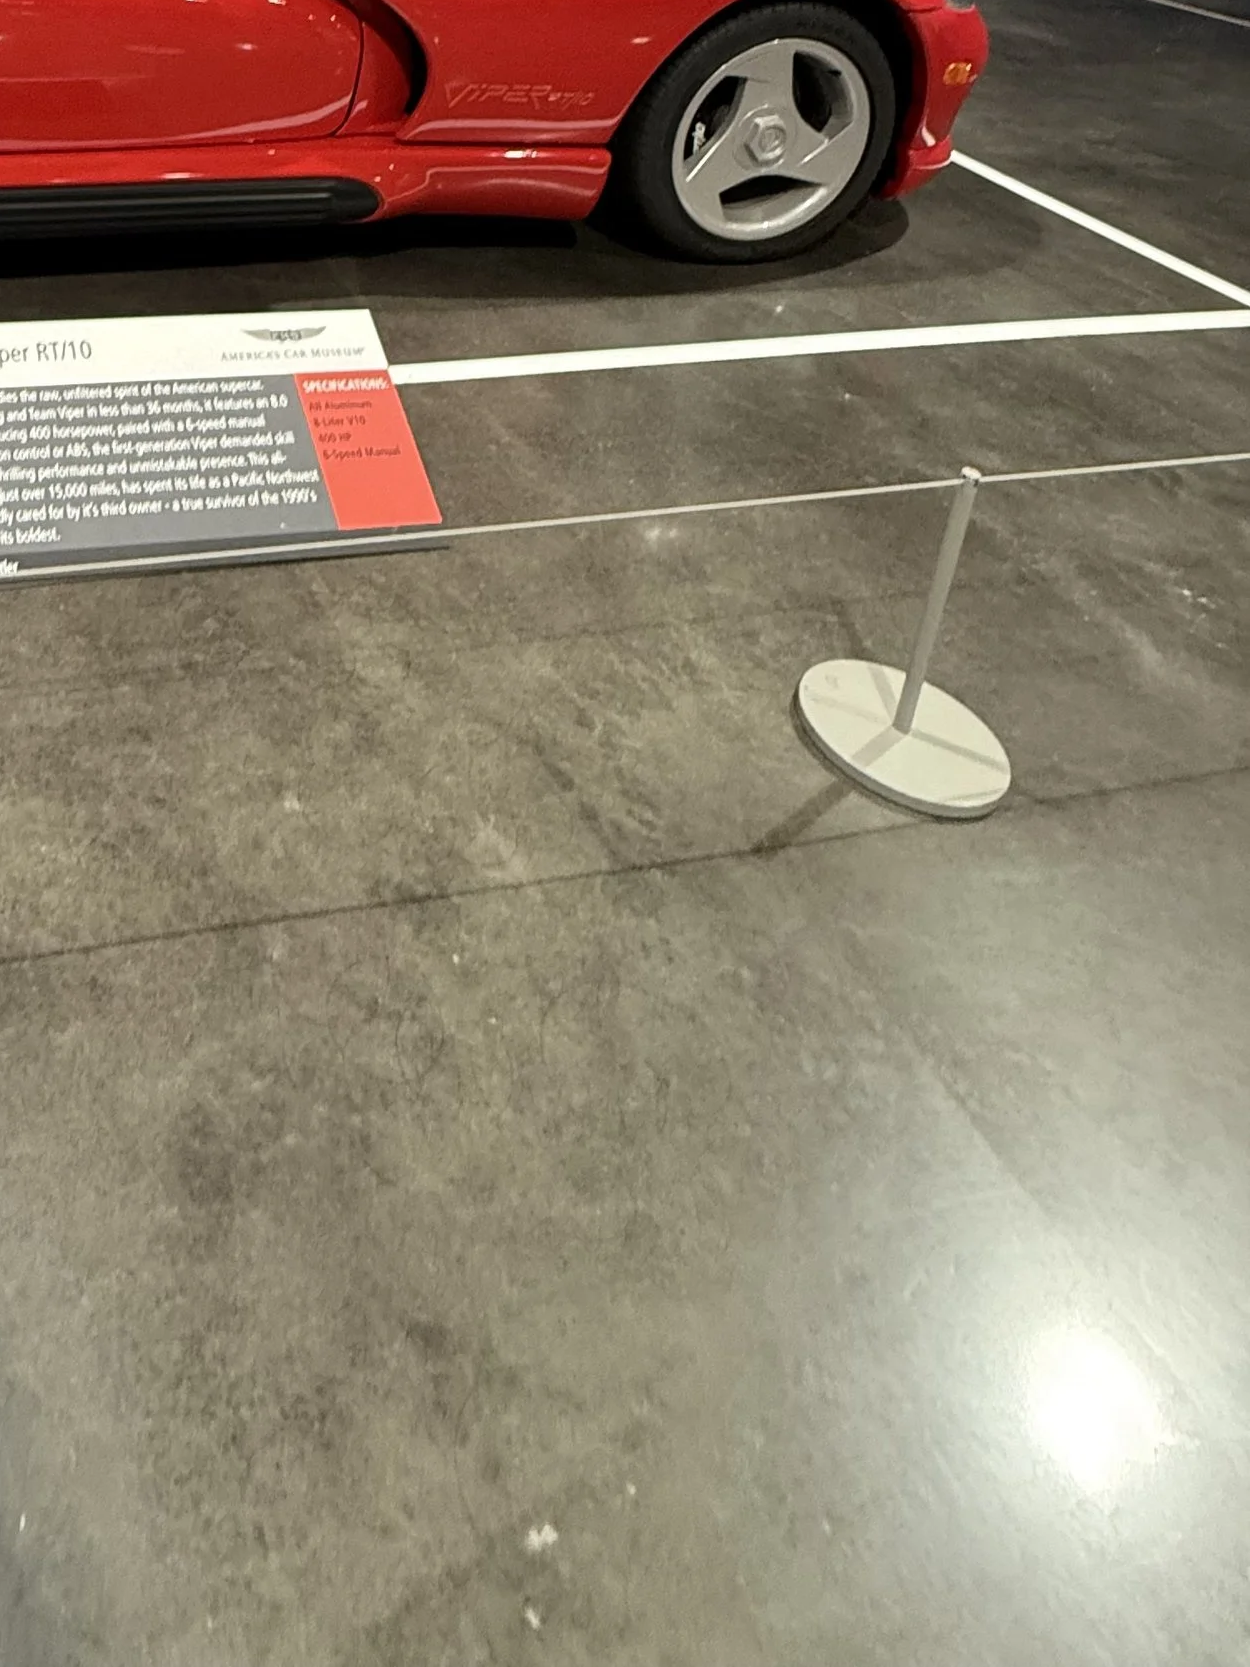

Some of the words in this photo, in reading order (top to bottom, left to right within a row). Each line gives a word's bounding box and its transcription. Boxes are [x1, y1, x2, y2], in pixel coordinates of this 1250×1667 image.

[36, 340, 92, 361] RT/10
[19, 389, 37, 402] the
[38, 390, 61, 401] raw,
[62, 385, 112, 400] unfiltered
[113, 385, 138, 399] spirit
[140, 382, 151, 396] of
[153, 383, 170, 395] the
[171, 382, 218, 394] American
[219, 380, 264, 394] supercar.
[6, 407, 27, 422] and
[28, 406, 57, 420] Team
[56, 405, 84, 421] Viper
[85, 404, 97, 417] in
[98, 403, 119, 416] less
[120, 402, 144, 416] than
[146, 400, 161, 414] 36
[162, 399, 203, 413] months,
[212, 396, 254, 410] features
[255, 397, 268, 408] an
[269, 394, 287, 408] 8.0
[29, 425, 50, 439] 400
[51, 424, 116, 439] horsepower,
[116, 420, 149, 437] paired
[151, 418, 175, 433] with
[176, 420, 184, 431] a
[184, 416, 226, 432] 6-speed
[227, 413, 265, 428] manual
[0, 530, 13, 544] its
[15, 527, 61, 543] boldest.
